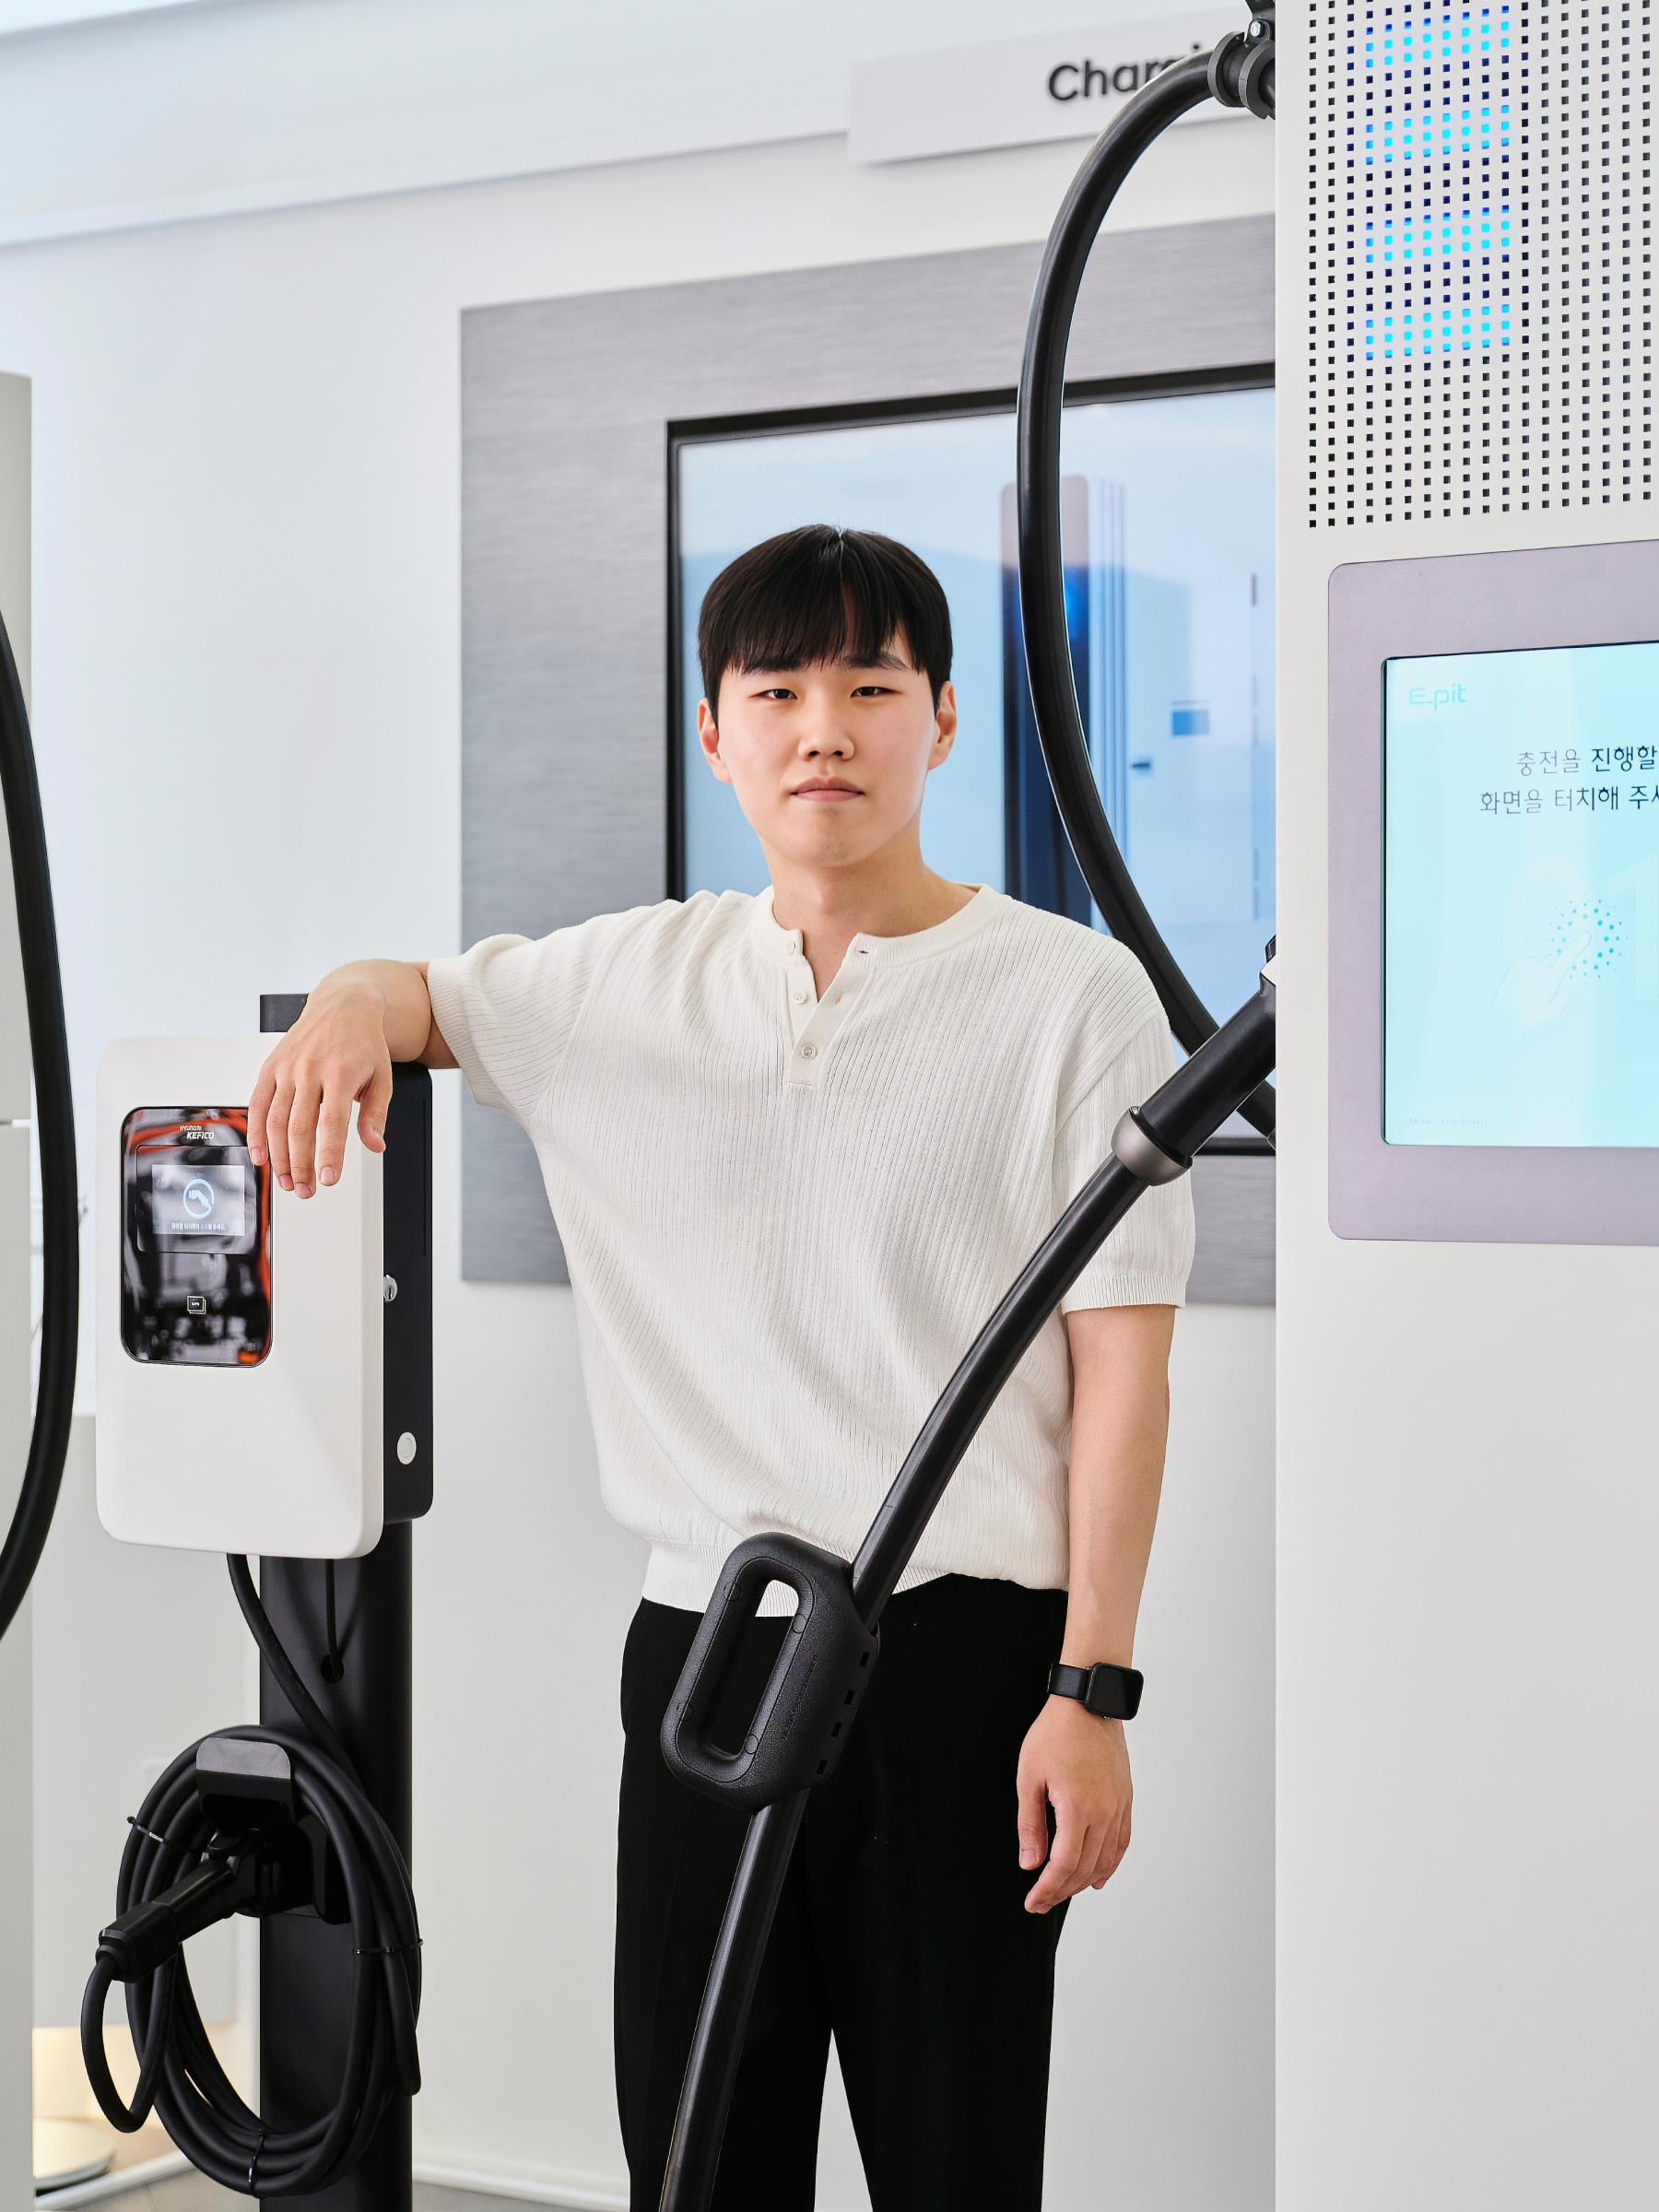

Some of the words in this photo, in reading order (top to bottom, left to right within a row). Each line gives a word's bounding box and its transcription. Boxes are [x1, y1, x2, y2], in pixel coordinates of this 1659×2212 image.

[1517, 748, 1582, 777] 충전을
[1591, 745, 1658, 772] 진행할
[1479, 788, 1544, 815] 화면을
[1554, 785, 1618, 812] 터치해
[1628, 783, 1659, 810] 주
[186, 1131, 215, 1140] KEFICO
